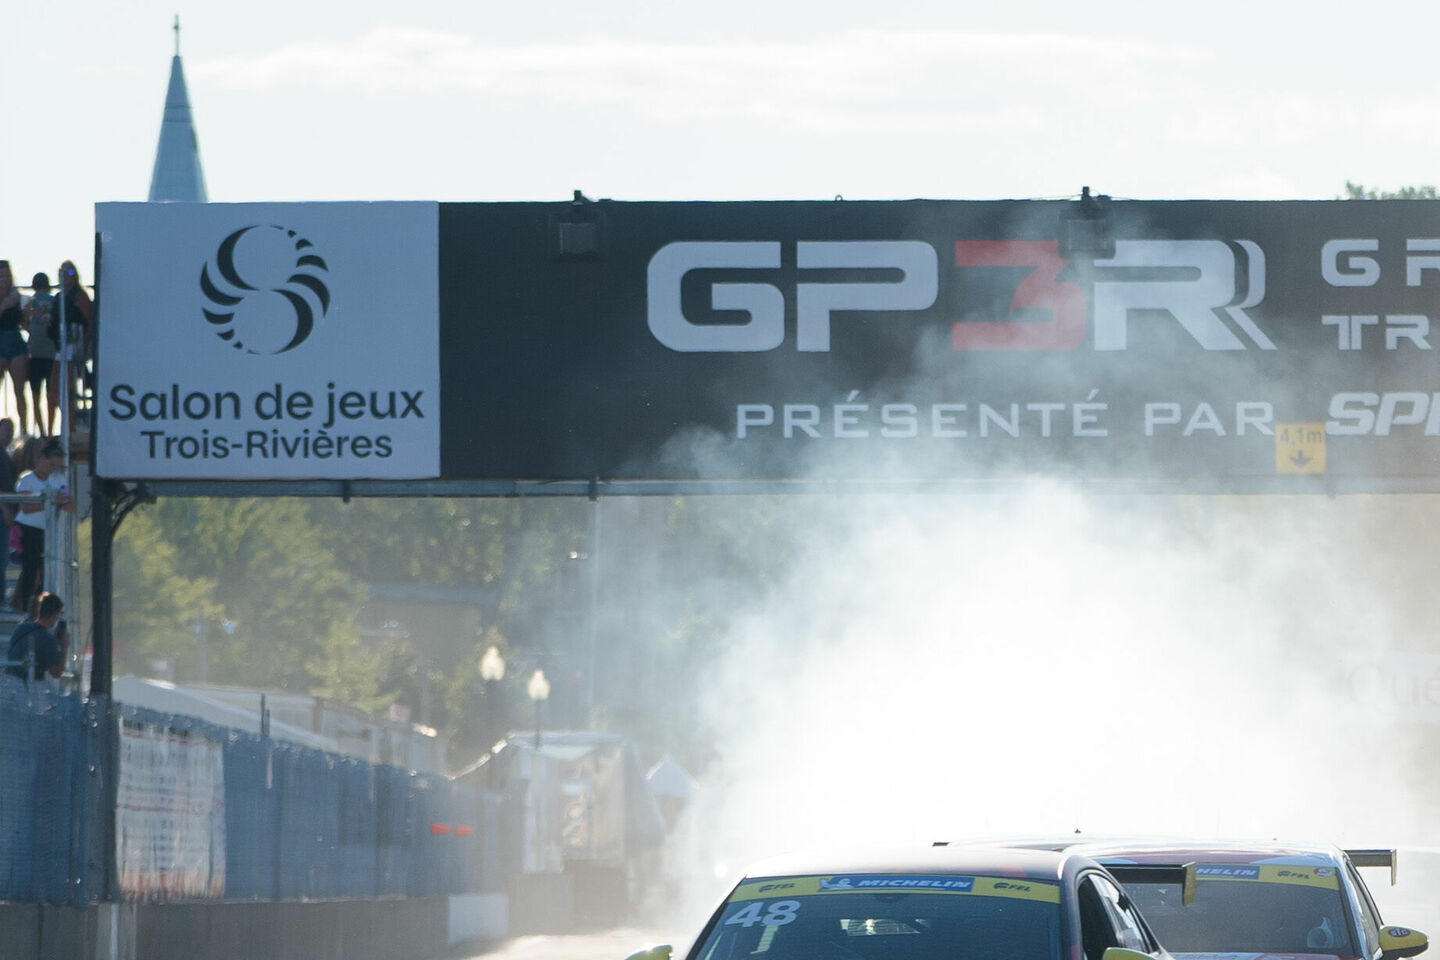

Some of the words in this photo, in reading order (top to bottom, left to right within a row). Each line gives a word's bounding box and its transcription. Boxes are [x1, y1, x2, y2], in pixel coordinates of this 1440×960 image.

[647, 240, 1277, 352] GP3R
[108, 383, 242, 421] Salon
[254, 383, 314, 420] de
[322, 382, 425, 429] jeux
[736, 389, 1108, 440] PRÉSENTÉ
[1144, 400, 1275, 436] PAR
[140, 428, 393, 459] Trois-Rivières
[857, 879, 972, 889] MICHELIN
[724, 900, 801, 928] 48
